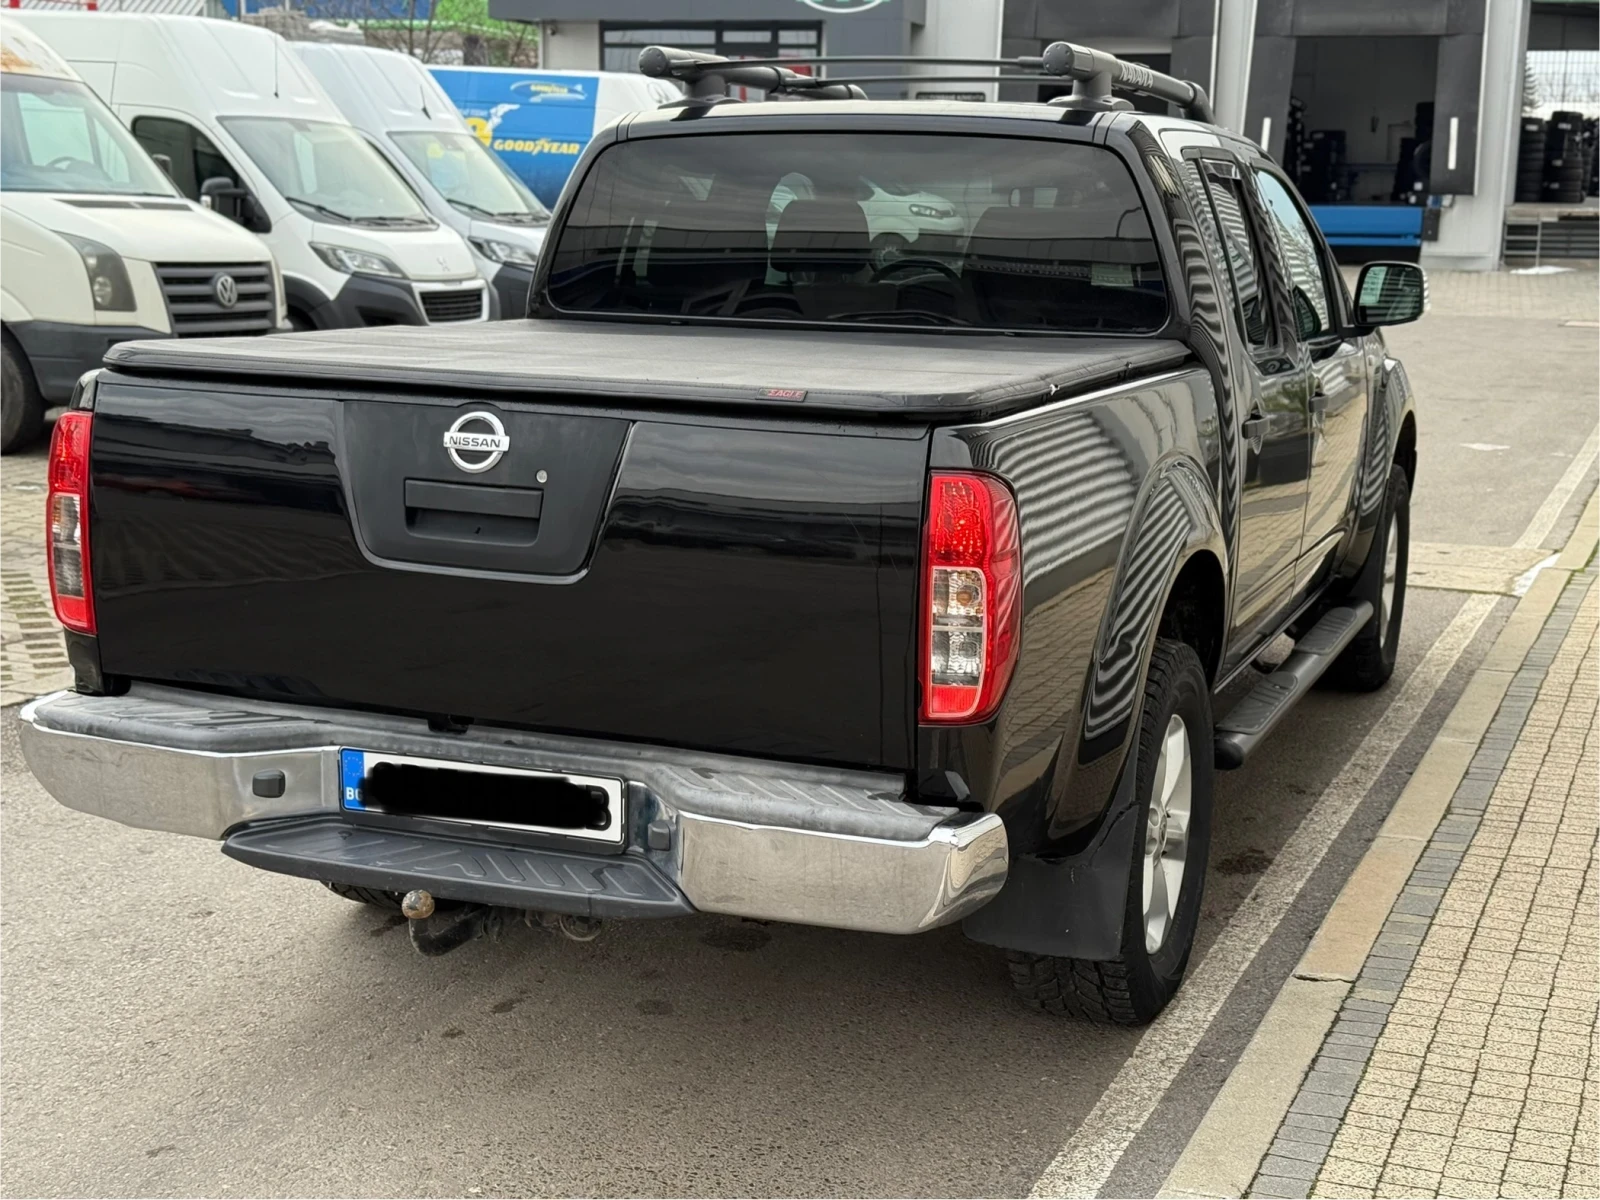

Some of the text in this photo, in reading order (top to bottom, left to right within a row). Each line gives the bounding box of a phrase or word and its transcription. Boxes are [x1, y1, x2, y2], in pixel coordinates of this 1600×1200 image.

[1119, 62, 1154, 88] NAVARA
[493, 138, 580, 156] GOODYEAR
[767, 388, 805, 399] EAGLE
[448, 435, 501, 448] NISSAN
